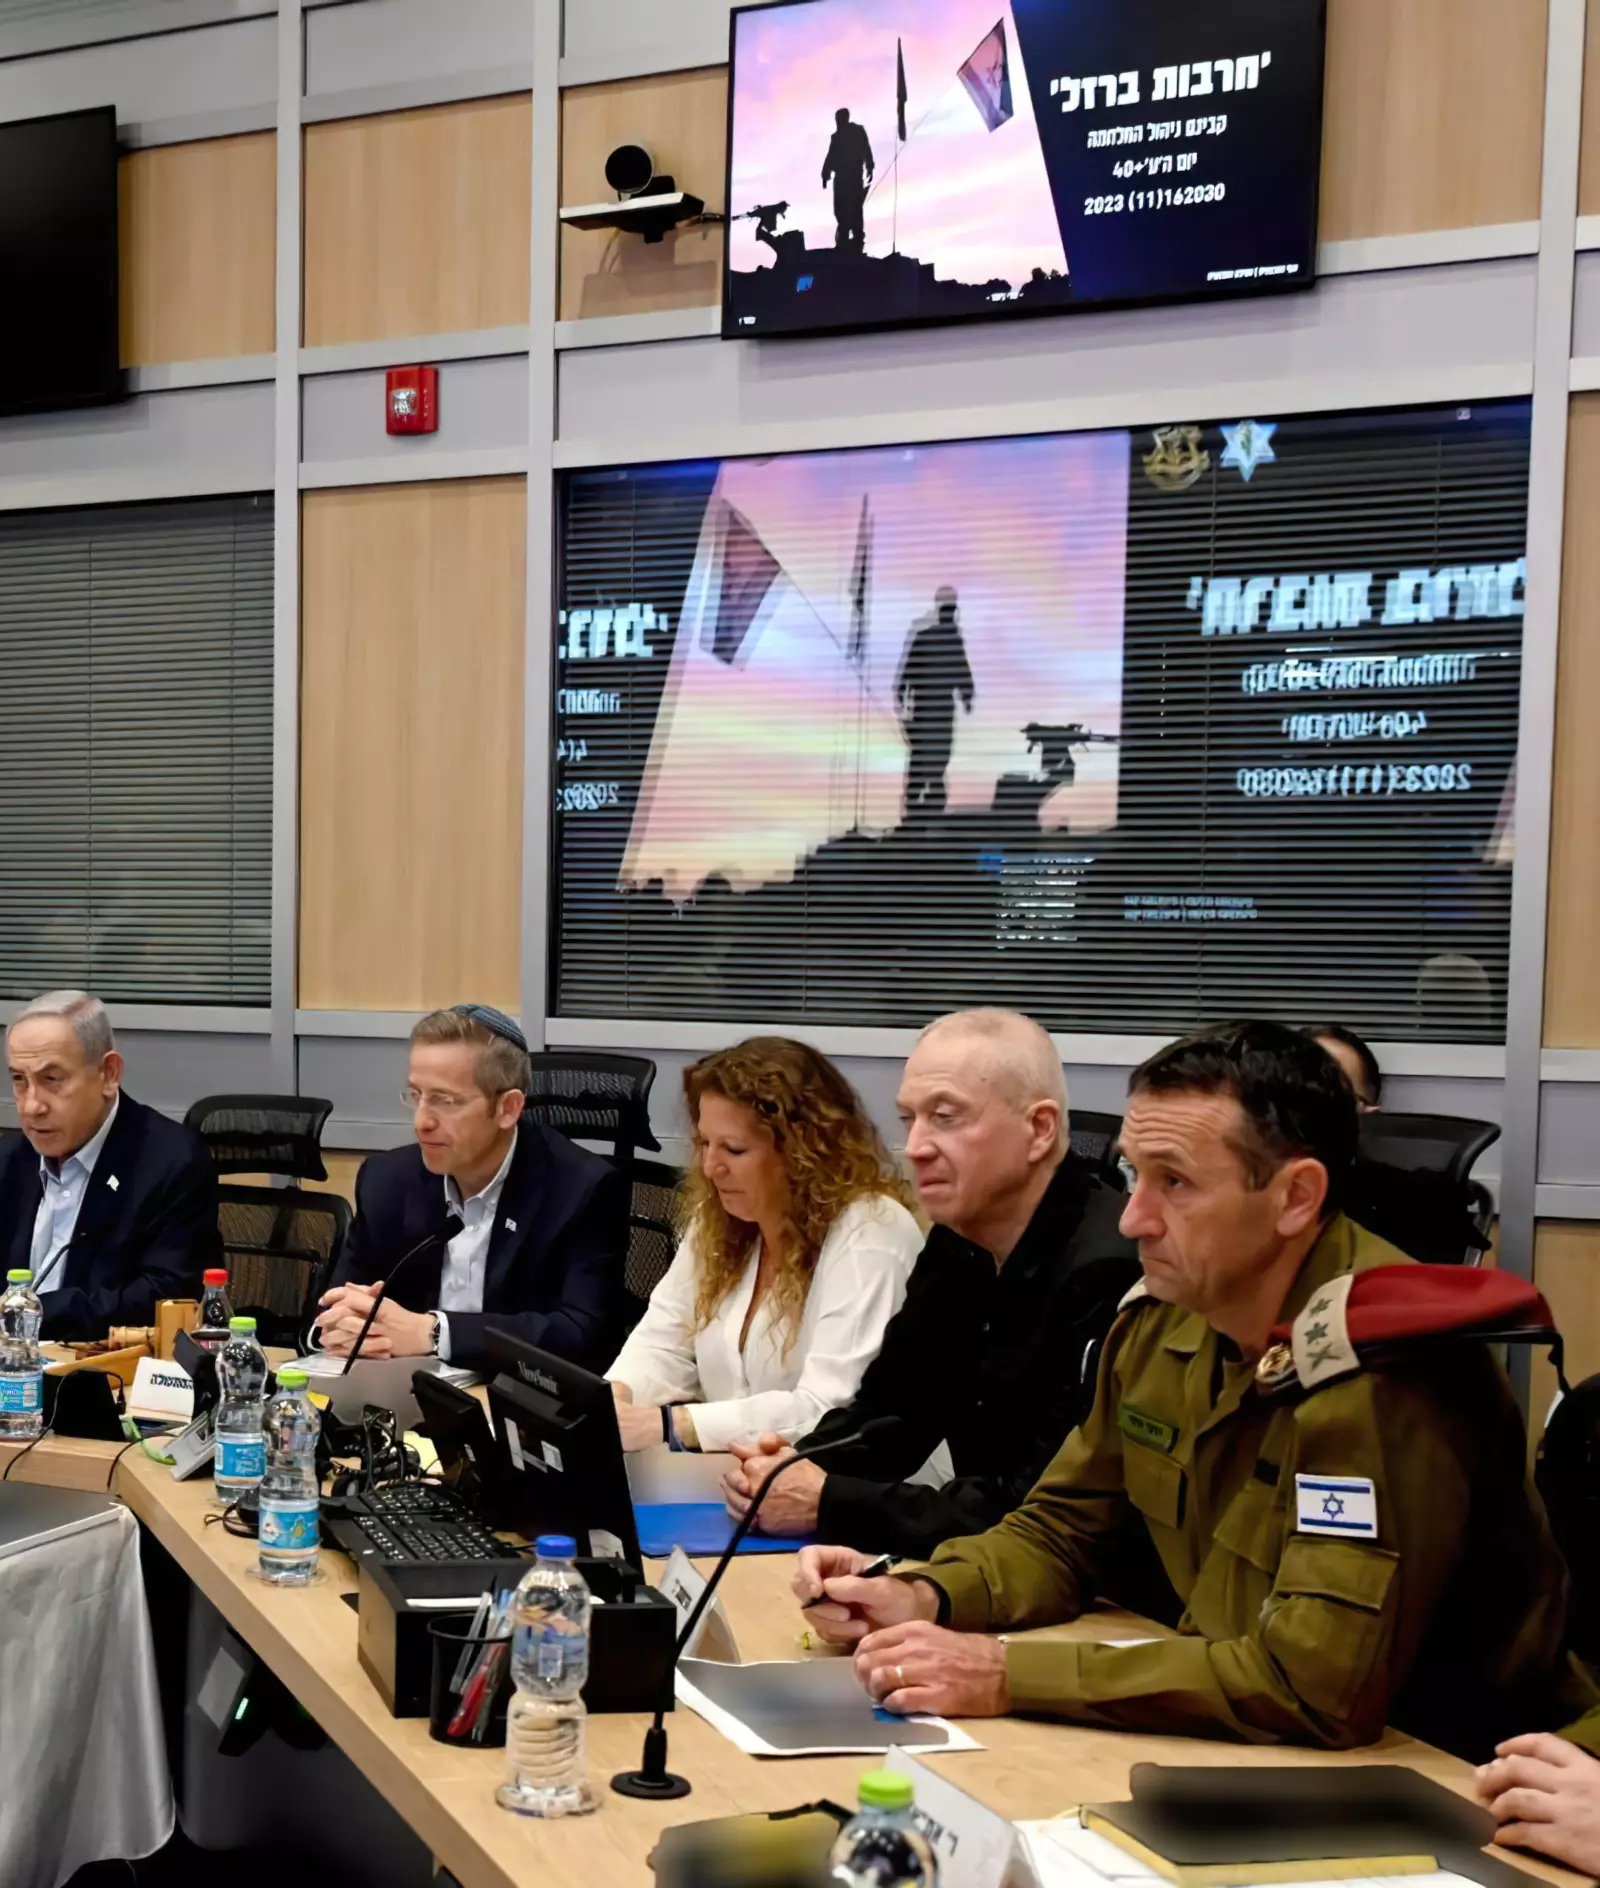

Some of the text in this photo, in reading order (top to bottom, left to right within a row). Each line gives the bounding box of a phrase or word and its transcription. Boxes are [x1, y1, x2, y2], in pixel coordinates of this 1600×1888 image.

[1146, 120, 1182, 142] ניהול
[1176, 152, 1198, 172] יום
[1084, 194, 1125, 216] 2023
